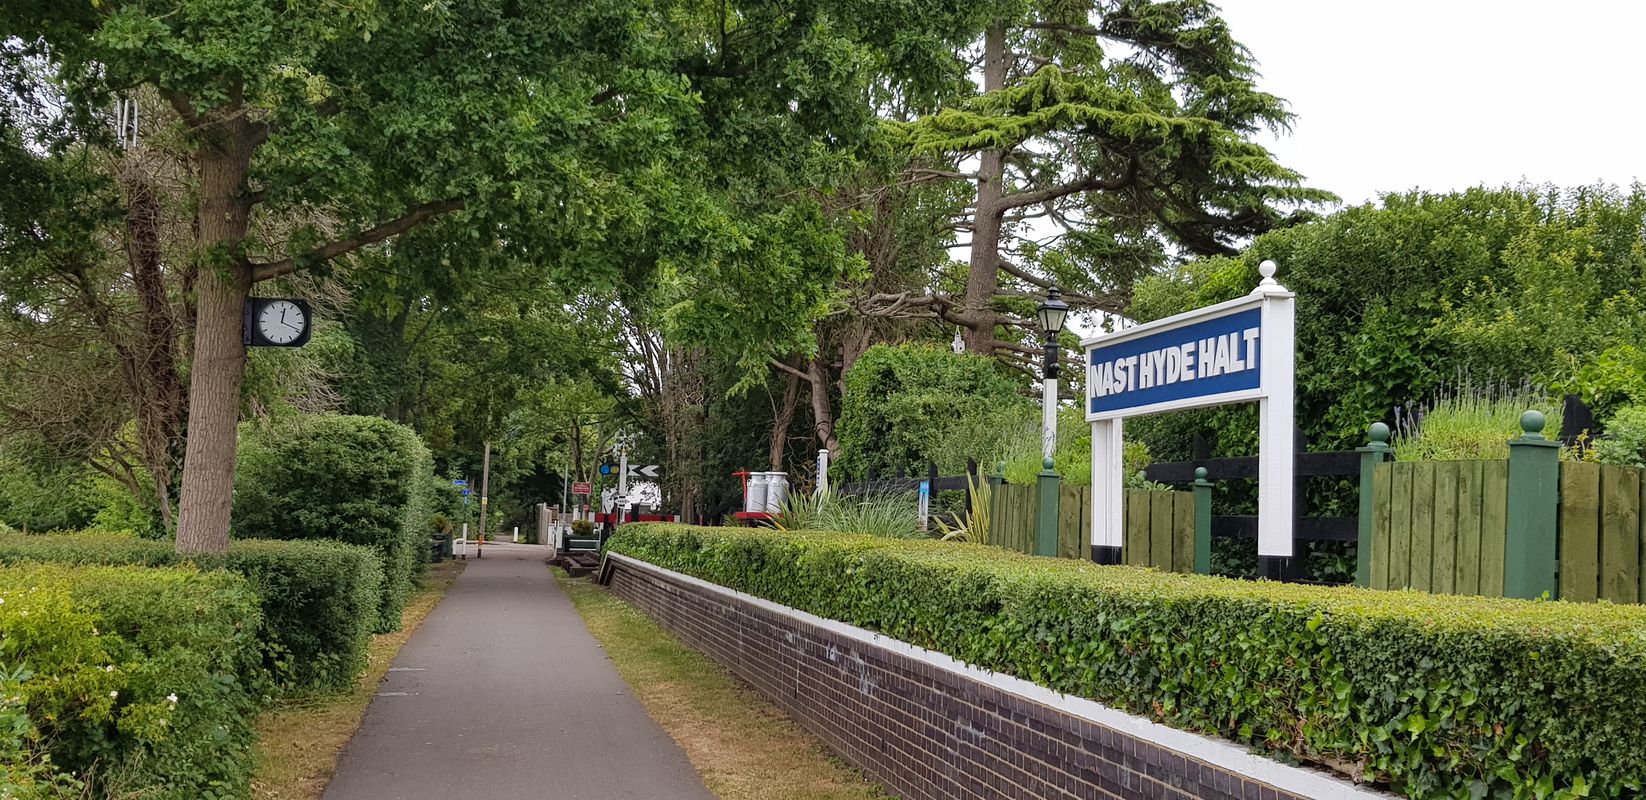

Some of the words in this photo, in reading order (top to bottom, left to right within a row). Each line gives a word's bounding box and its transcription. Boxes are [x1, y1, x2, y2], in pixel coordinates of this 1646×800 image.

[1091, 356, 1138, 398] NAST
[1139, 342, 1196, 389] HYDE
[1198, 327, 1260, 379] HALT
